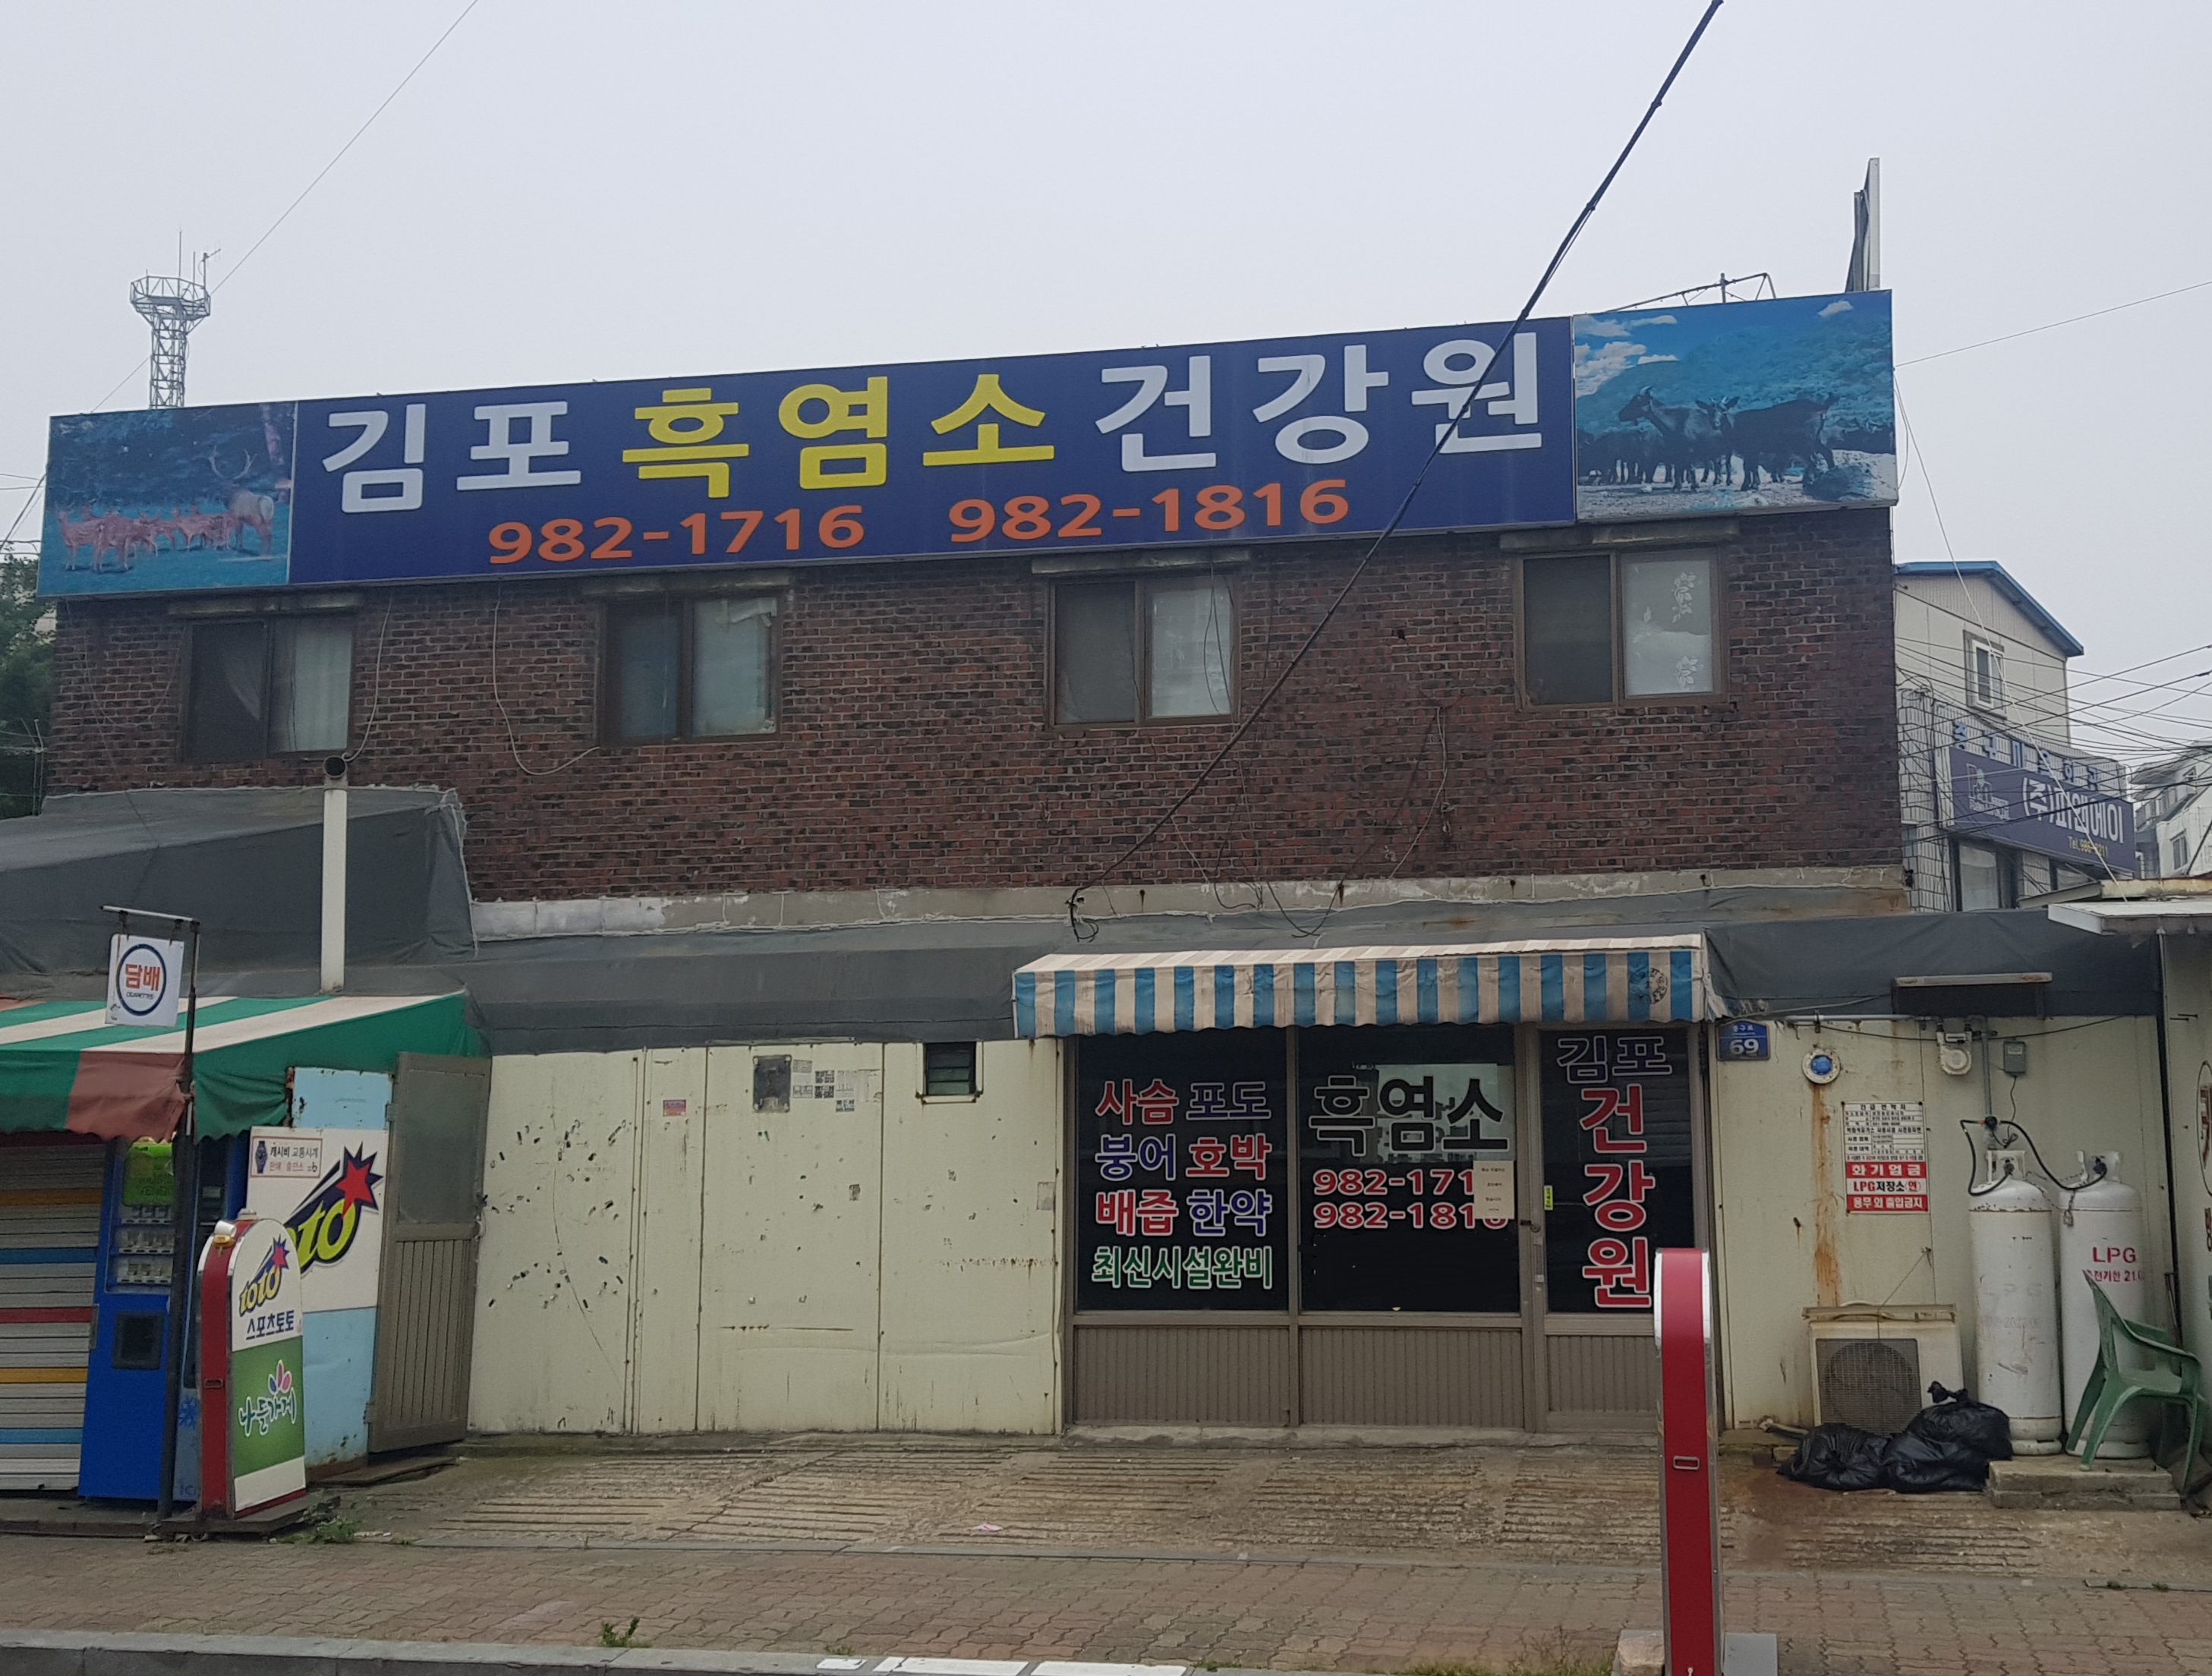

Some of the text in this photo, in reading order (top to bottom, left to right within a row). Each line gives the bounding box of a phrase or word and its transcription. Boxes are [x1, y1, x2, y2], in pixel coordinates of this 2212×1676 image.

[322, 332, 1542, 513] 김포 흑염소 건강원
[487, 479, 1350, 564] 982-1716 982-1816
[125, 963, 161, 992] 담배
[1556, 1035, 1672, 1084] 김포
[1729, 1038, 1759, 1055] 69
[1095, 1078, 1272, 1125] 사슴 포도
[1308, 1074, 1510, 1158] 흑염소
[1094, 1133, 1272, 1181] 붕어 호박
[1313, 1168, 1475, 1196] 982-171
[1095, 1188, 1273, 1237] 배즙 한약
[1090, 1246, 1273, 1290] 최신시설완비
[2086, 1269, 2121, 1283] 전기한
[2093, 1246, 2137, 1263] LPG
[246, 1309, 295, 1340] 스포츠토토
[238, 1387, 298, 1437] 나들가게
